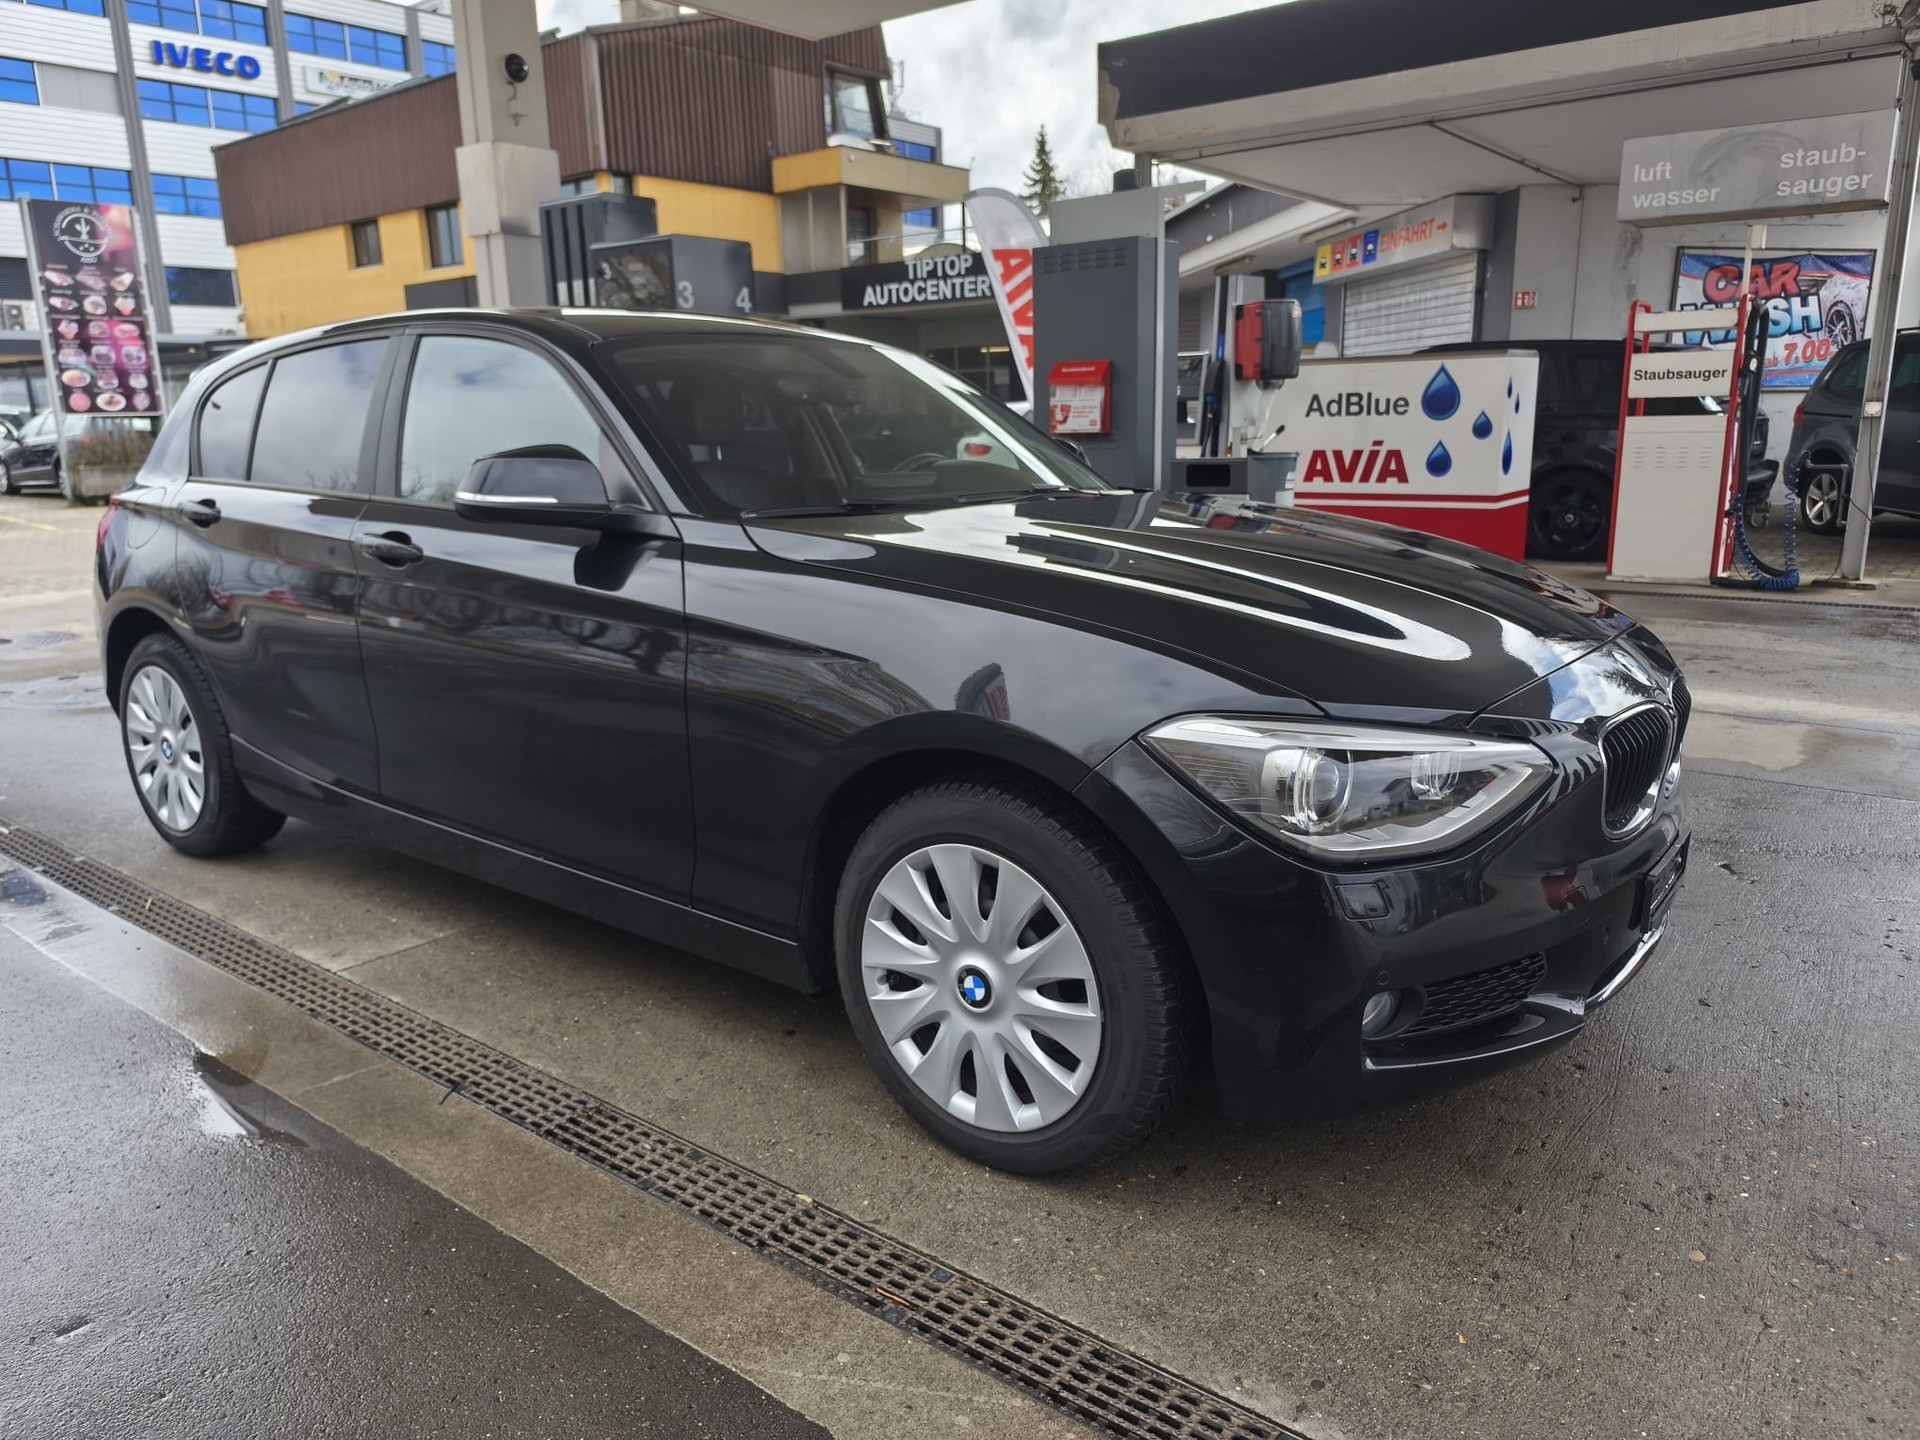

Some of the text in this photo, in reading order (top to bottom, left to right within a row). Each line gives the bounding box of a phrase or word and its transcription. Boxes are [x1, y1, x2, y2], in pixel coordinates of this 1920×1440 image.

[151, 40, 261, 79] IVECO
[1779, 142, 1867, 169] staub-
[1633, 161, 1673, 183] luft
[1776, 172, 1873, 198] sauger
[1633, 185, 1721, 209] wasser
[1380, 218, 1436, 253] EINFAHRT
[905, 254, 974, 280] TIPTOP
[677, 281, 695, 309] 3
[862, 275, 992, 307] AUTOCENTER
[1703, 261, 1801, 303] CAR
[735, 287, 752, 313] 4
[1679, 293, 1824, 345] WSH
[1633, 366, 1729, 382] Staubsauger
[1304, 391, 1411, 418] AdBlue
